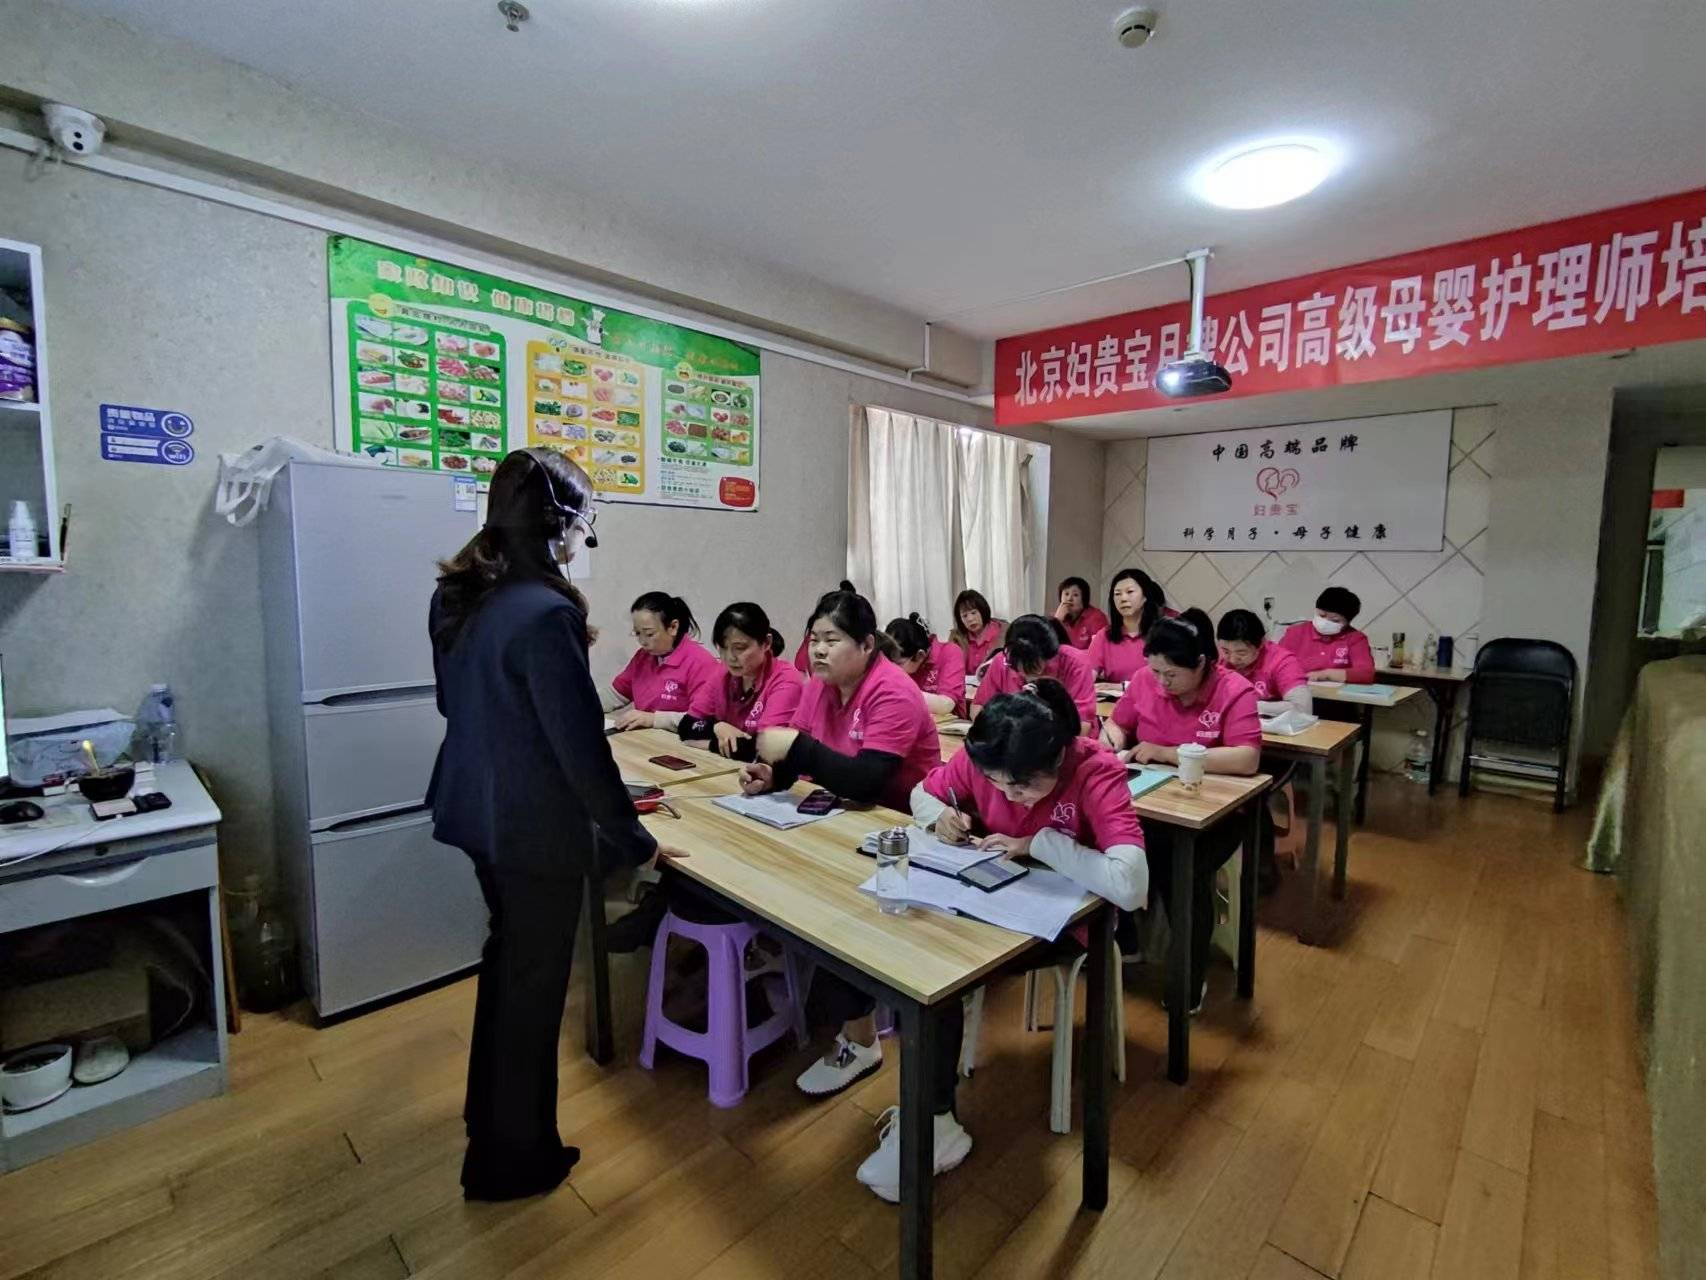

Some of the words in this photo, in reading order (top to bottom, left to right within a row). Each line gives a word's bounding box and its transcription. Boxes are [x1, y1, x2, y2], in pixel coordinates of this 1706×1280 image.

[1212, 433, 1359, 463] 中国高端品牌
